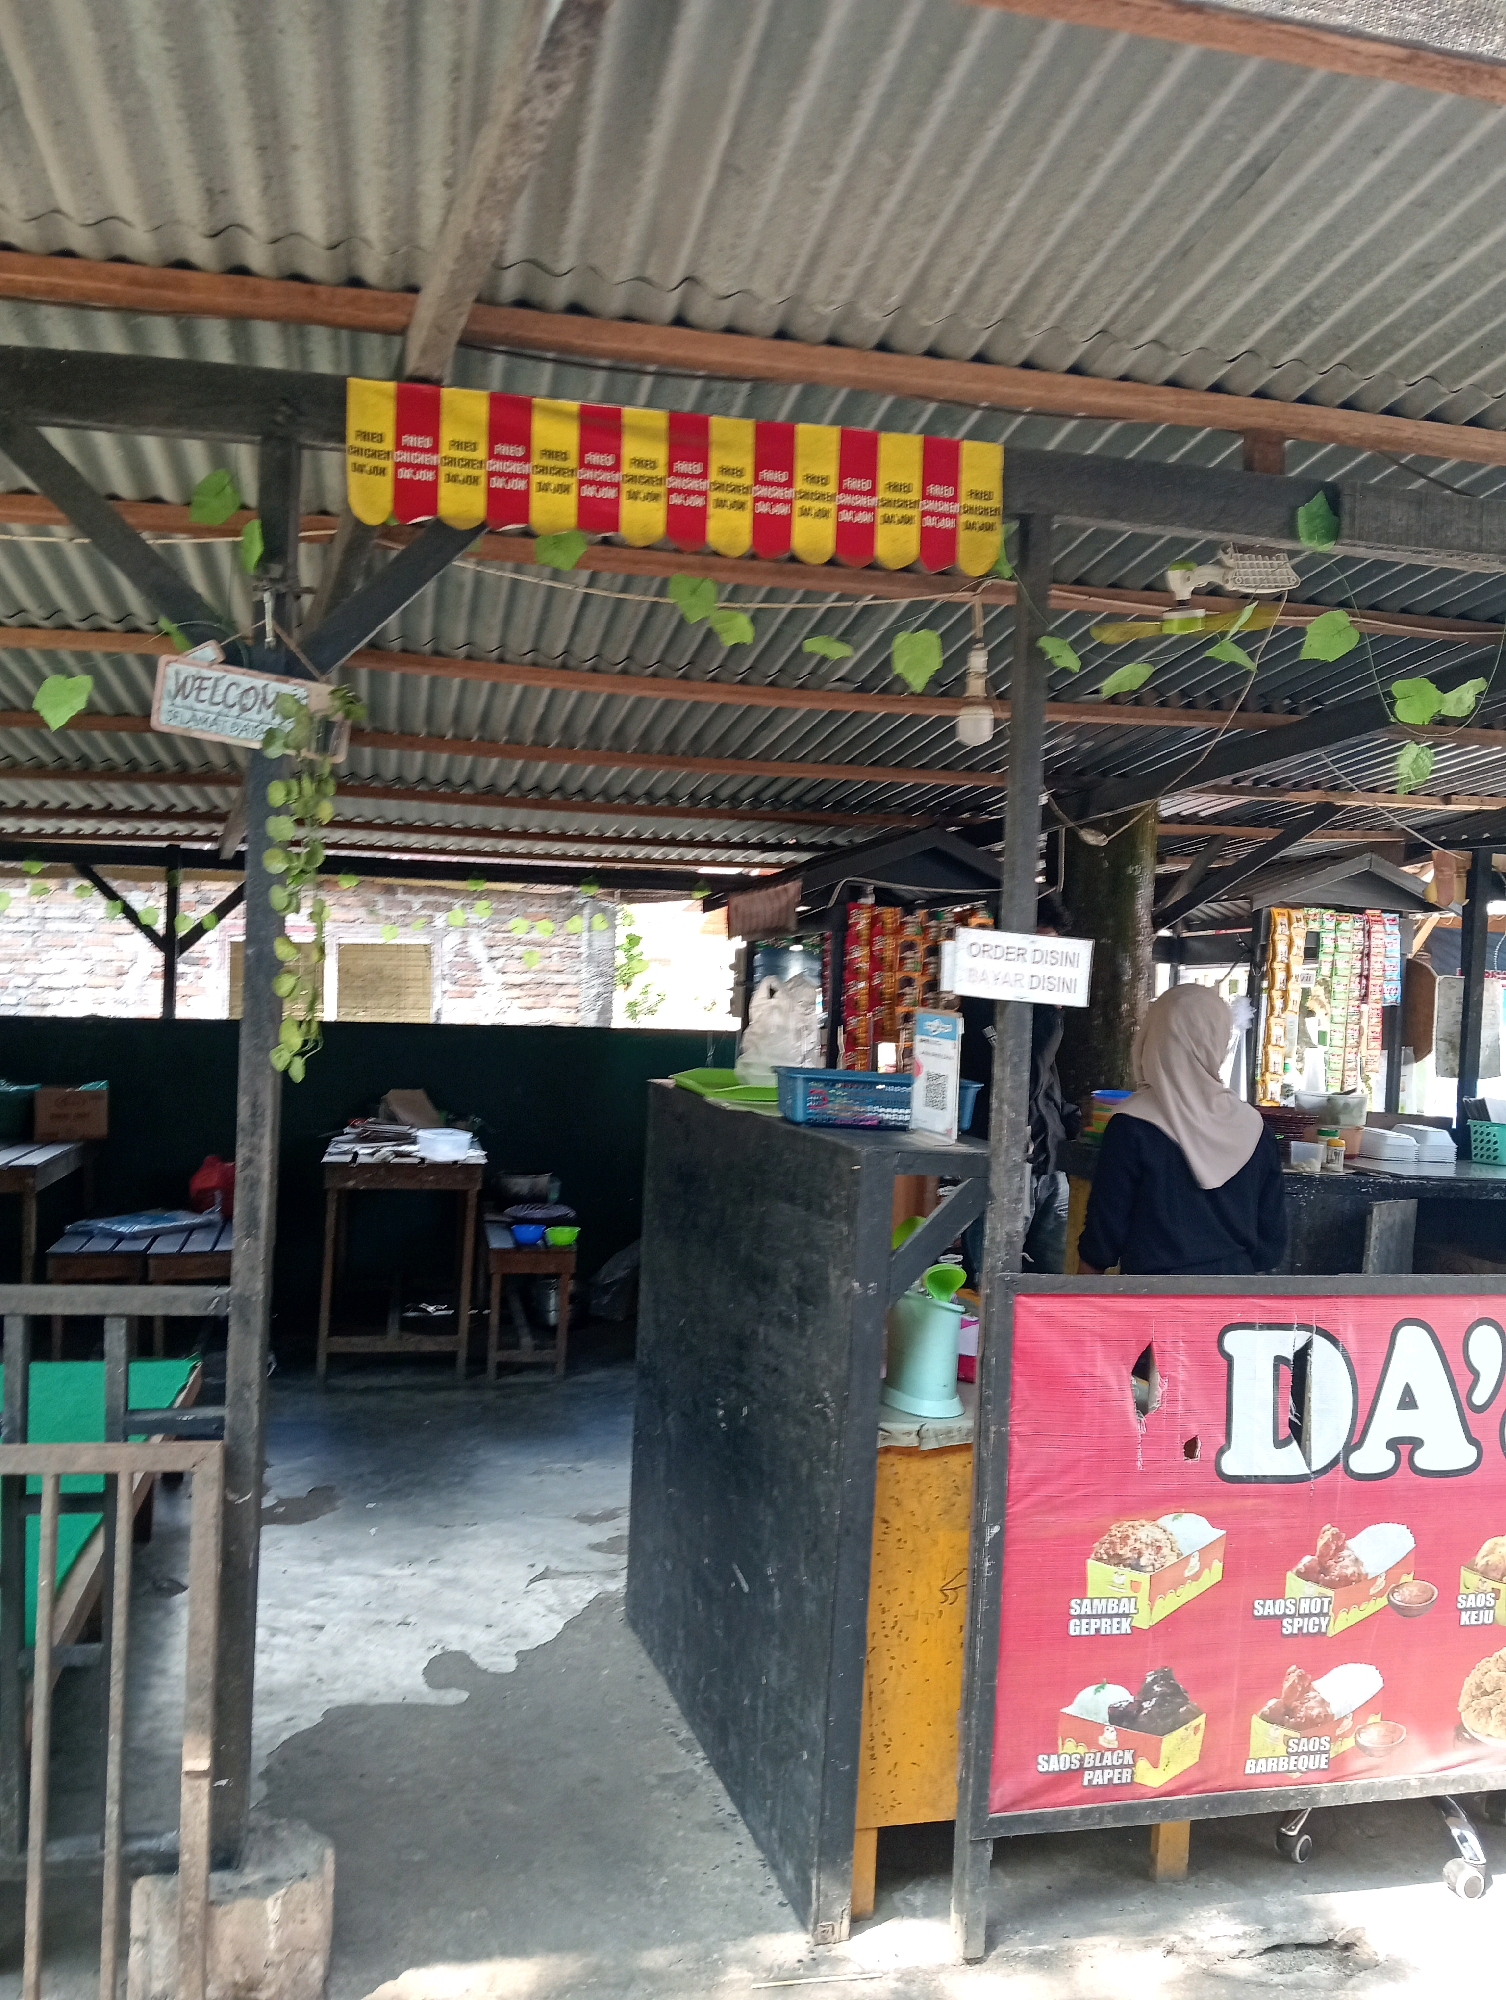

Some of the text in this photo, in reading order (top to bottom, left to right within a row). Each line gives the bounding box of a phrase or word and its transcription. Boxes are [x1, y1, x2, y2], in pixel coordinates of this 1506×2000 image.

[402, 434, 433, 448] FRIED
[494, 443, 525, 457] FRIED
[927, 484, 954, 498] FRIED
[968, 942, 1080, 969] ORDER DISINI
[968, 968, 1077, 994] BAYAR DISINI
[1216, 1317, 1506, 1484] DA'
[1069, 1597, 1138, 1616] SAMBAL
[1253, 1597, 1331, 1616] SAOS HOT
[1457, 1593, 1496, 1609] SAOS
[1069, 1617, 1132, 1636] GEPREK
[1282, 1616, 1330, 1635] SPICY
[1460, 1610, 1495, 1626] KEJU
[1287, 1736, 1331, 1753] SAOS
[1037, 1750, 1135, 1772] SAOS BLACK
[1244, 1753, 1330, 1775] BARBEQUE
[1082, 1768, 1132, 1786] PAPER
